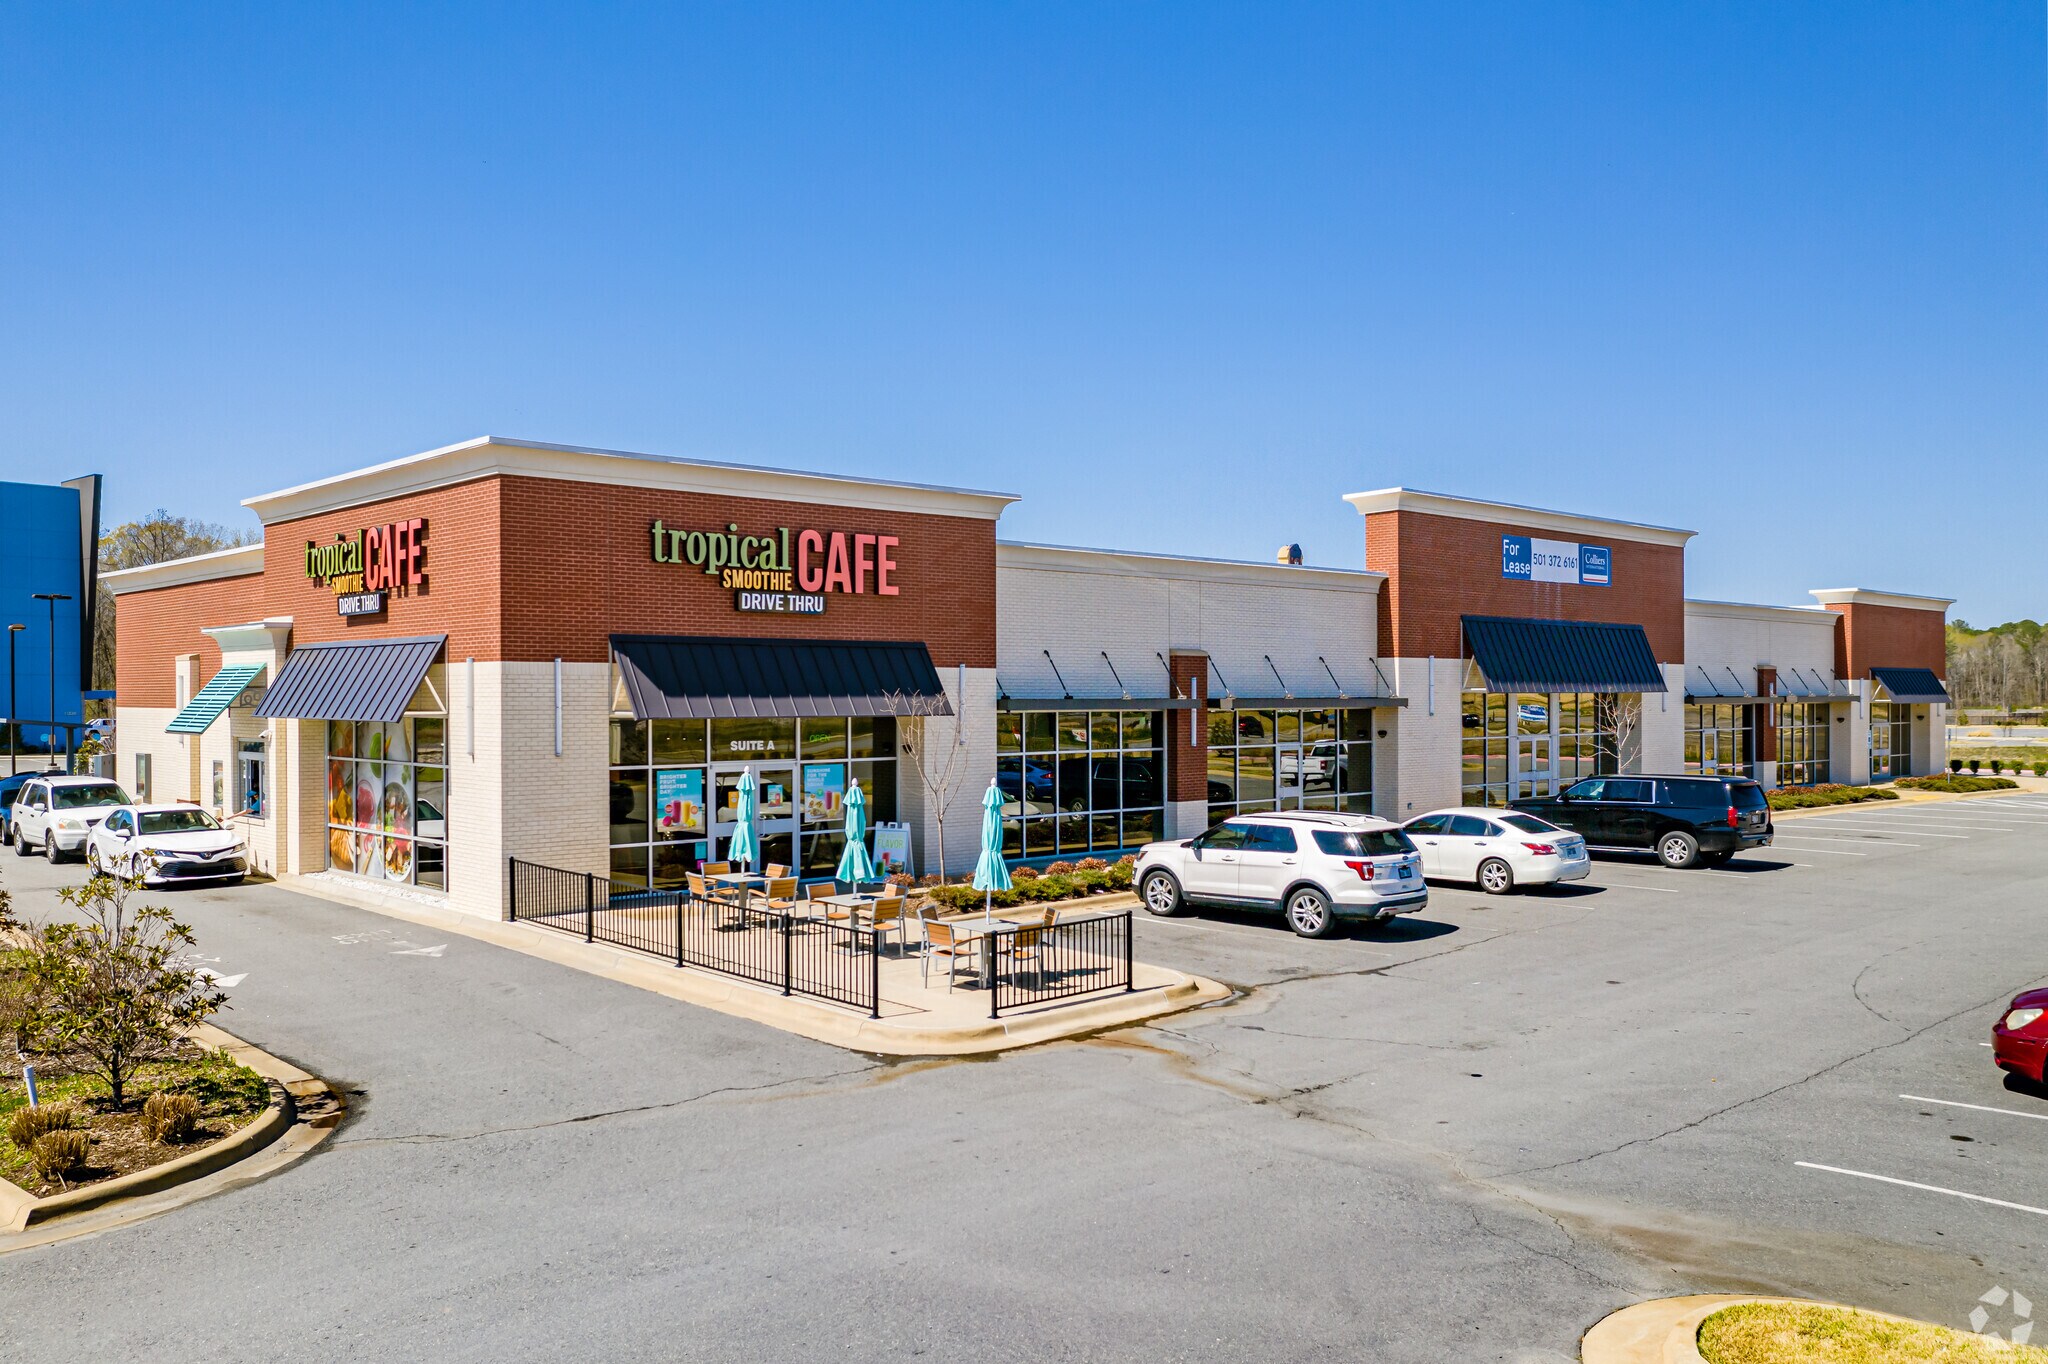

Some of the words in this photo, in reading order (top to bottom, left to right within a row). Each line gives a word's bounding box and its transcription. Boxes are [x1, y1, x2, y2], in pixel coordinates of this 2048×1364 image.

[305, 529, 363, 584] tropical
[365, 518, 422, 591] CAFE
[652, 519, 792, 575] tropical
[798, 529, 899, 595] CAFE
[1503, 539, 1520, 556] For
[1503, 557, 1531, 574] Lease
[1533, 553, 1546, 565] 501
[1548, 555, 1561, 568] 372
[1563, 556, 1578, 569] 6161
[1585, 553, 1606, 565] Colliers
[332, 573, 364, 595] SMOOTHIE
[722, 568, 792, 591] SMOOTHIE
[339, 595, 360, 614] DRIVE
[361, 593, 380, 611] THRU
[741, 592, 784, 611] DRIVE
[787, 594, 824, 613] THRU
[730, 740, 764, 751] SUITE
[766, 740, 775, 750] A
[877, 839, 904, 849] FLAVOR
